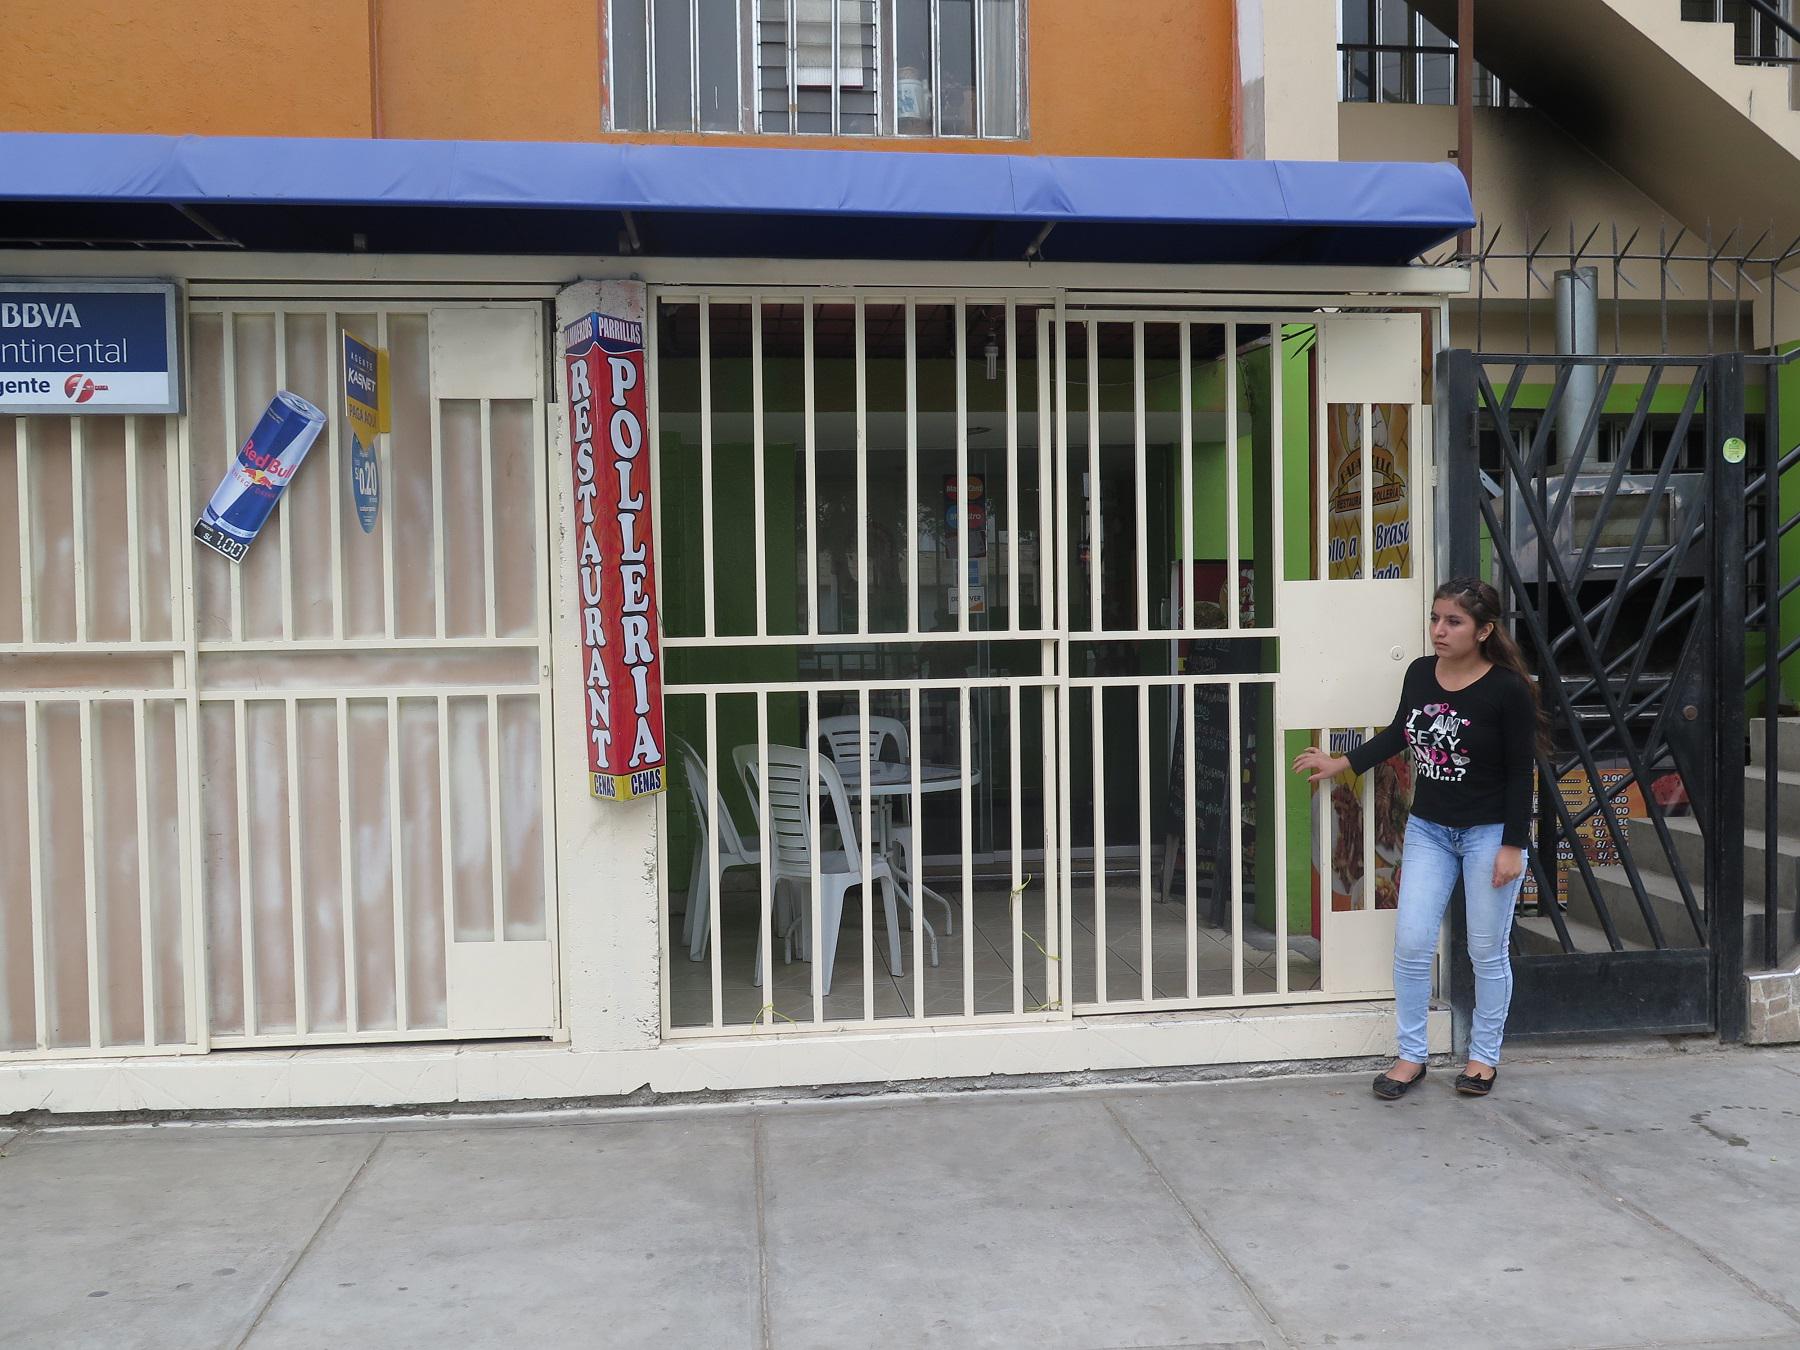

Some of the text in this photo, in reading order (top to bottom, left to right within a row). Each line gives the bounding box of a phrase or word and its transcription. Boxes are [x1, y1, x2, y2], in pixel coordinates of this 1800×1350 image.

[1, 303, 81, 328] BBVA
[598, 316, 641, 345] PARRILLAS
[347, 367, 377, 393] KASNET
[243, 439, 298, 479] Red Bull
[570, 359, 612, 769] RESTAURANT
[607, 356, 662, 769] POLLERIA
[1405, 708, 1461, 738] I AM
[1407, 729, 1461, 752] SEXY
[593, 773, 616, 799] CENAS
[630, 768, 662, 796] CENAS
